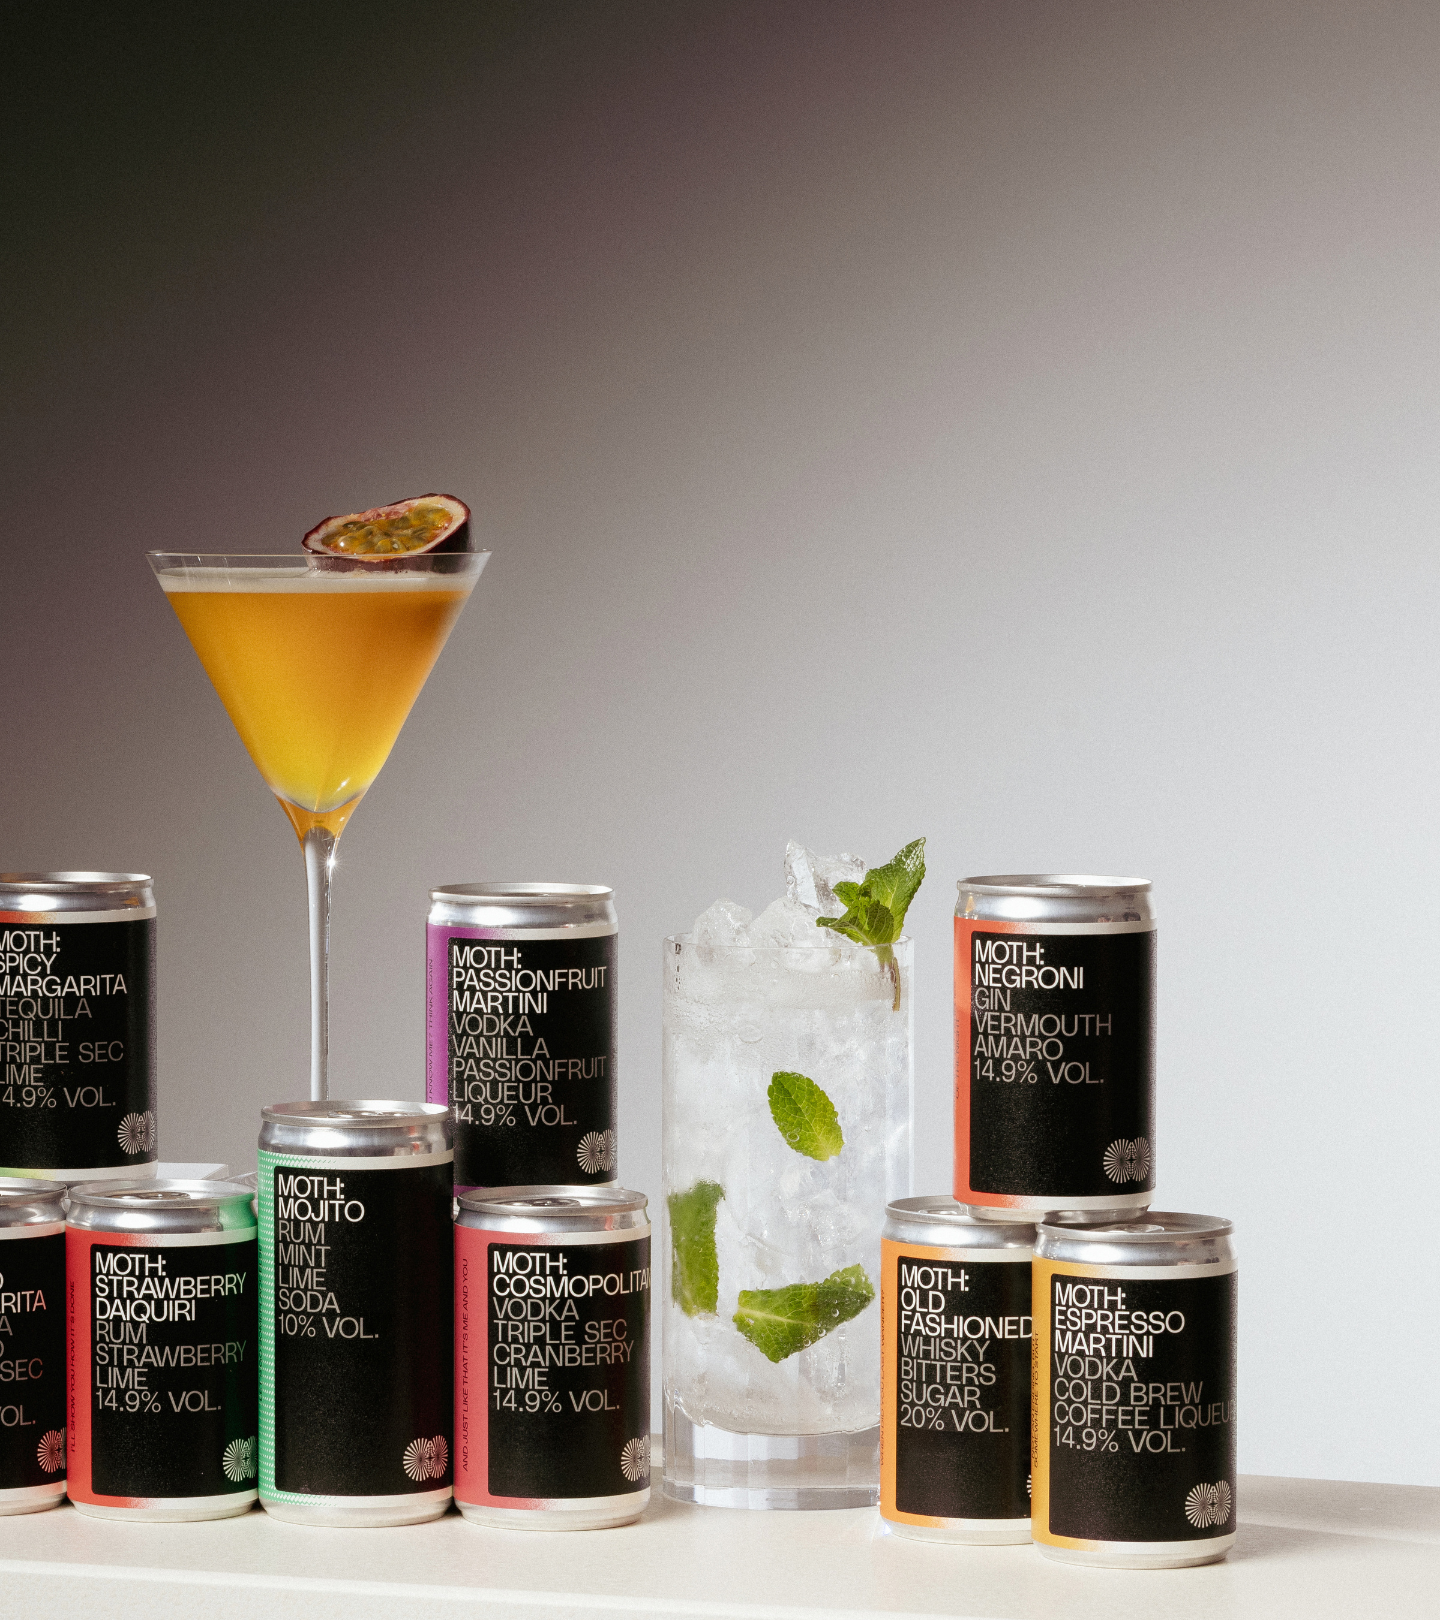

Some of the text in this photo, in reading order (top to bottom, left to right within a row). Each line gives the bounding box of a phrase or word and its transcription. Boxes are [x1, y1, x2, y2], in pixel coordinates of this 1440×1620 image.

[452, 945, 521, 968] MOTH:
[976, 939, 1044, 965] MOTH:
[452, 966, 607, 991] PASSIONFRUIT
[974, 963, 1083, 989] NEGRONI
[452, 991, 547, 1013] MARTINI
[974, 987, 1010, 1012] GIN
[452, 1013, 533, 1036] VODKA
[974, 1012, 1111, 1036] VERMOUTH
[79, 1041, 123, 1062] SEC
[452, 1035, 549, 1060] VANILLA
[974, 1037, 1063, 1060] AMARO
[453, 1055, 606, 1081] PASSIONFRUIT
[974, 1059, 1103, 1084] 14.9% VOL.
[63, 1087, 115, 1107] VOL.
[453, 1080, 552, 1104] LIQUEUR
[454, 1103, 577, 1126] 14.9% VOL.
[279, 1174, 344, 1199] MOTH:
[279, 1198, 364, 1222] MOJITO
[279, 1221, 324, 1244] RUM
[96, 1252, 166, 1276] MOTH:
[279, 1244, 330, 1267] MINT
[494, 1251, 567, 1274] MOTH:
[96, 1272, 246, 1298] STRAWBERRY
[279, 1267, 326, 1290] LIME
[902, 1264, 969, 1291] MOTH:
[279, 1289, 340, 1313] SODA
[901, 1288, 945, 1313] OLD
[1056, 1282, 1126, 1309] MOTH:
[96, 1299, 195, 1322] DAIQUIRI
[493, 1297, 579, 1320] VODKA
[1055, 1306, 1185, 1335] ESPRESSO
[97, 1322, 146, 1344] RUM
[279, 1314, 378, 1338] 10% VOL.
[463, 1312, 468, 1331] ME
[494, 1319, 627, 1343] TRIPLE SEC
[901, 1312, 1032, 1340] FASHIONED
[96, 1342, 245, 1367] STRAWBERRY
[494, 1340, 633, 1366] CRANBERRY
[901, 1335, 990, 1363] WHISKY
[1055, 1330, 1153, 1359] MARTINI
[0, 1358, 42, 1381] SEC
[97, 1367, 148, 1389] LIME
[494, 1366, 548, 1389] LIME
[901, 1358, 996, 1387] BITTERS
[1054, 1354, 1138, 1383] VODKA
[96, 1389, 221, 1412] 14.9% VOL.
[493, 1389, 619, 1412] 14.9% VOL.
[901, 1381, 980, 1410] SUGAR
[1055, 1378, 1202, 1406] COLD BREW
[901, 1404, 1009, 1432] 20% VOL.
[1054, 1401, 1231, 1430] COFFEE LIQUEU
[1054, 1426, 1185, 1452] 14.9% VOL.
